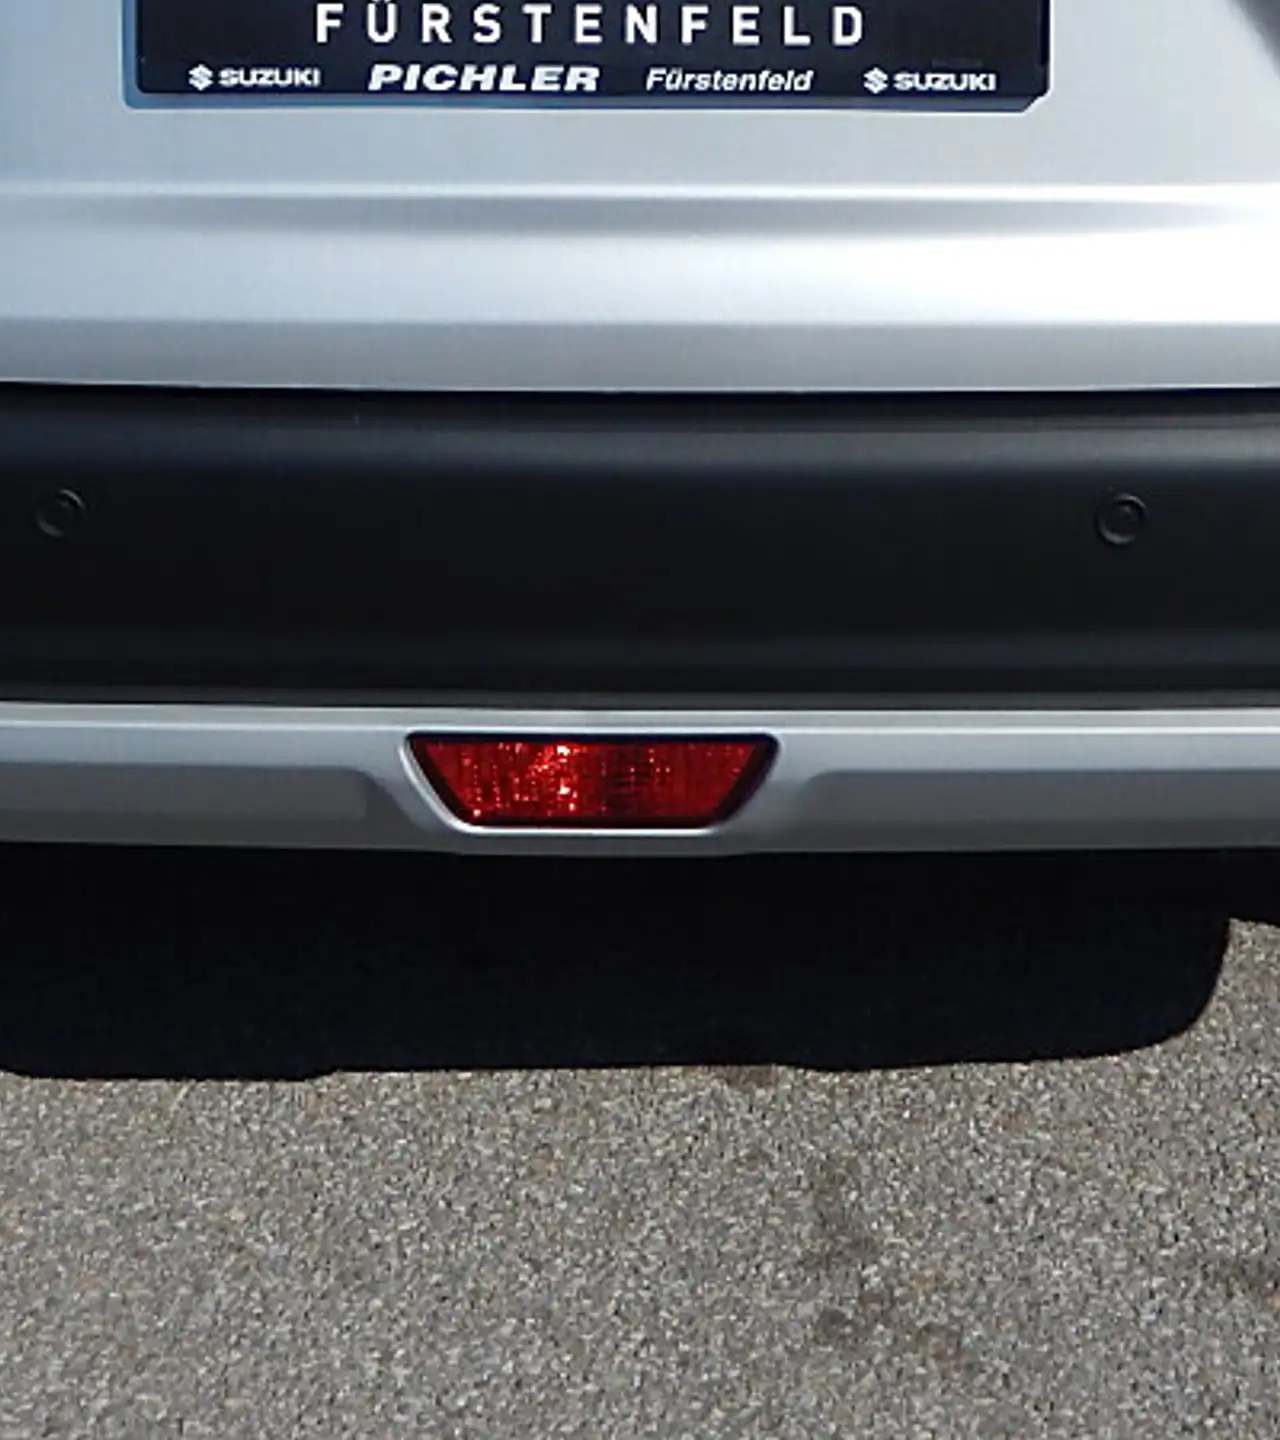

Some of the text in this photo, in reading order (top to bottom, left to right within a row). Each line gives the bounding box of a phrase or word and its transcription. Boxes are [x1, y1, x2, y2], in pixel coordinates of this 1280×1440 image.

[219, 63, 997, 92] SUZUKI PICHLER Fürstenfeld SUZUKI
